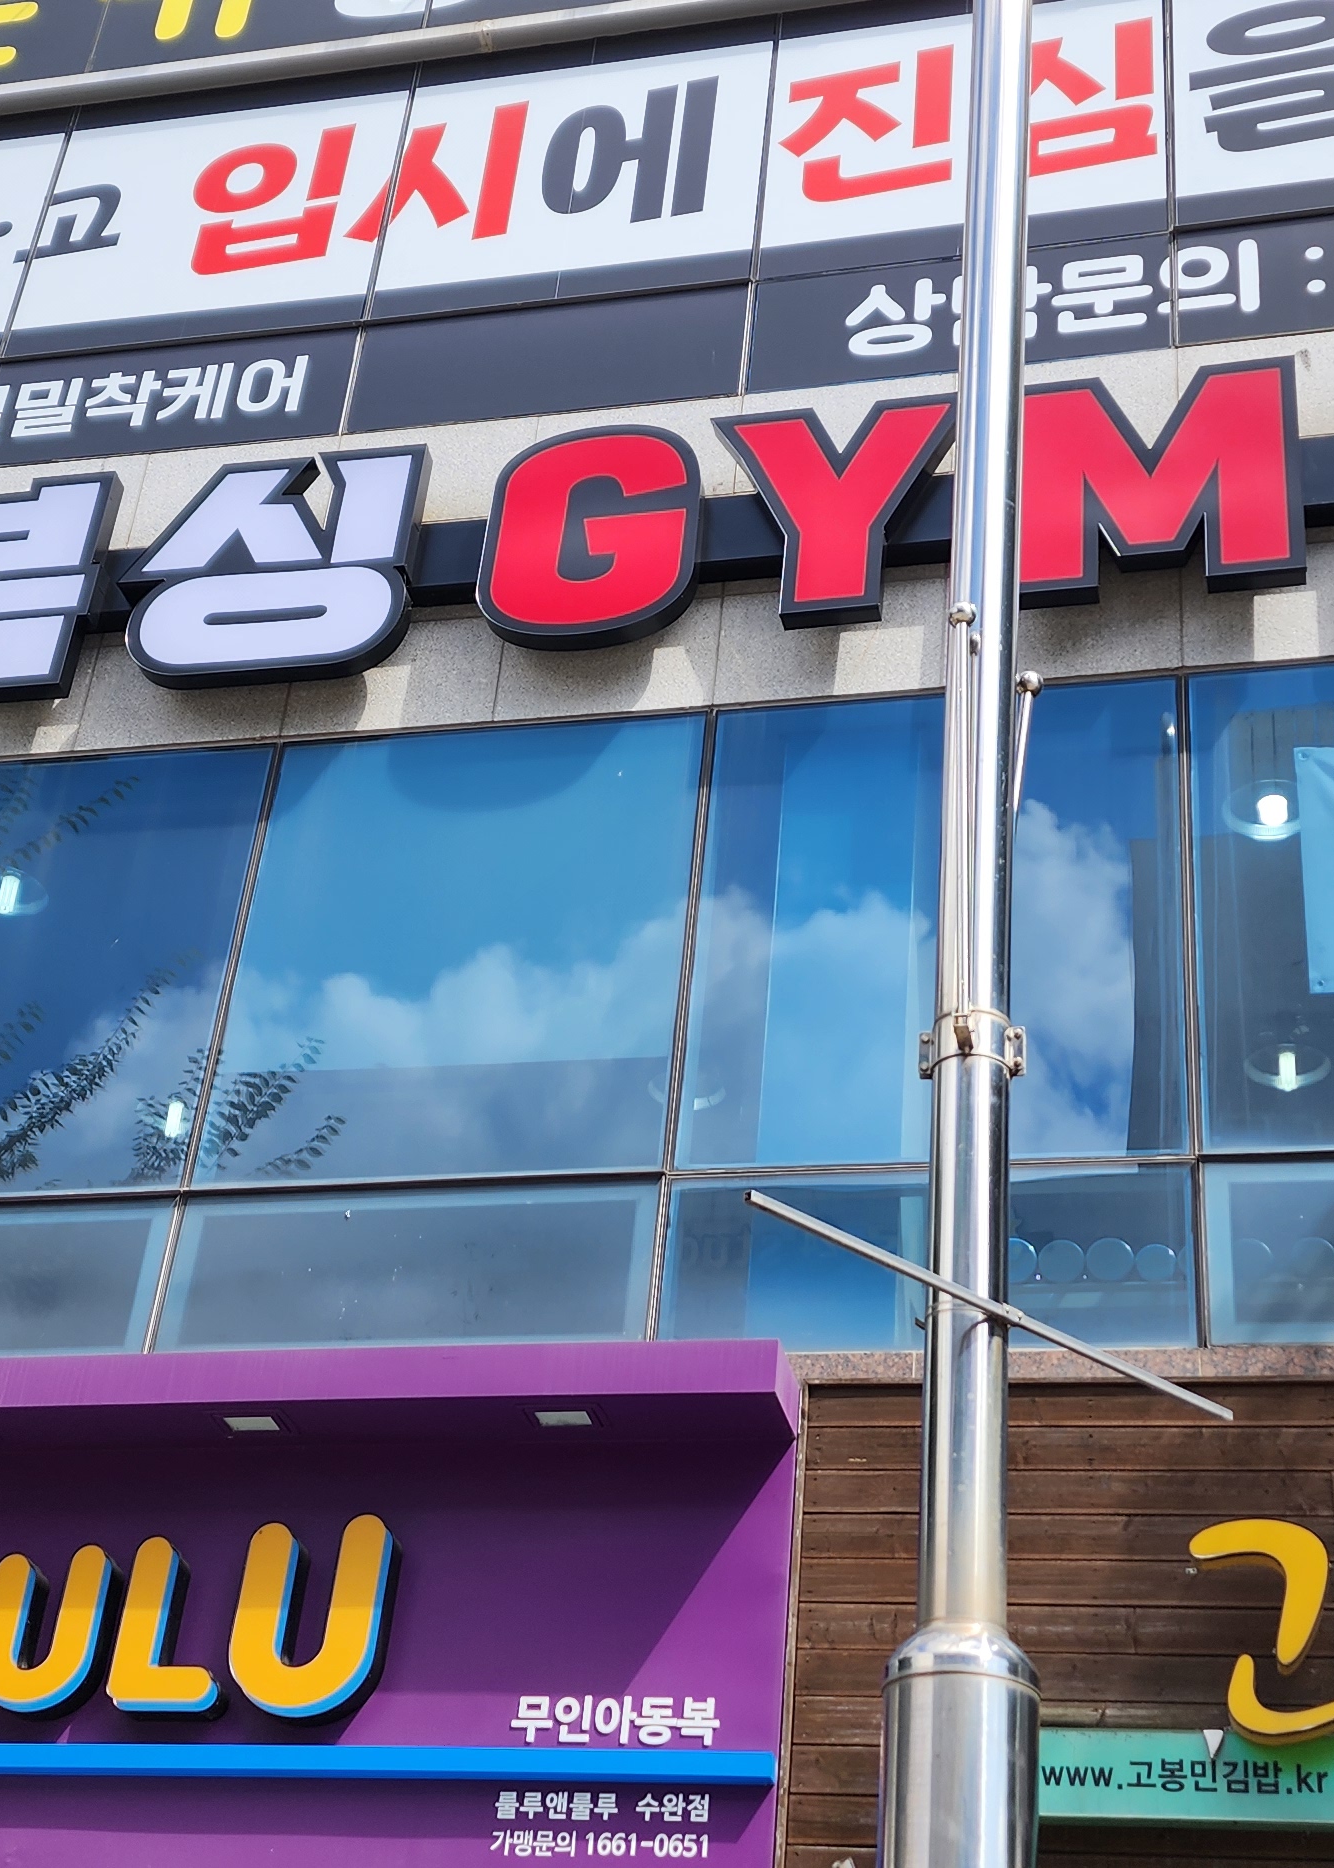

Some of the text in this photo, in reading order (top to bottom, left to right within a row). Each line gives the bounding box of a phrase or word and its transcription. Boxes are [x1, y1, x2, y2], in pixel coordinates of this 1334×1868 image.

[191, 75, 719, 275] 입시에
[846, 239, 1261, 356] 상문의
[481, 360, 1299, 634] GYM
[510, 1694, 721, 1746] 무인아동복
[1041, 1758, 1329, 1795] www.고봉민김밥.kr
[495, 1791, 710, 1823] 룰루앤룰루 수완점
[490, 1829, 709, 1859] 가맹문의 1661-0651
